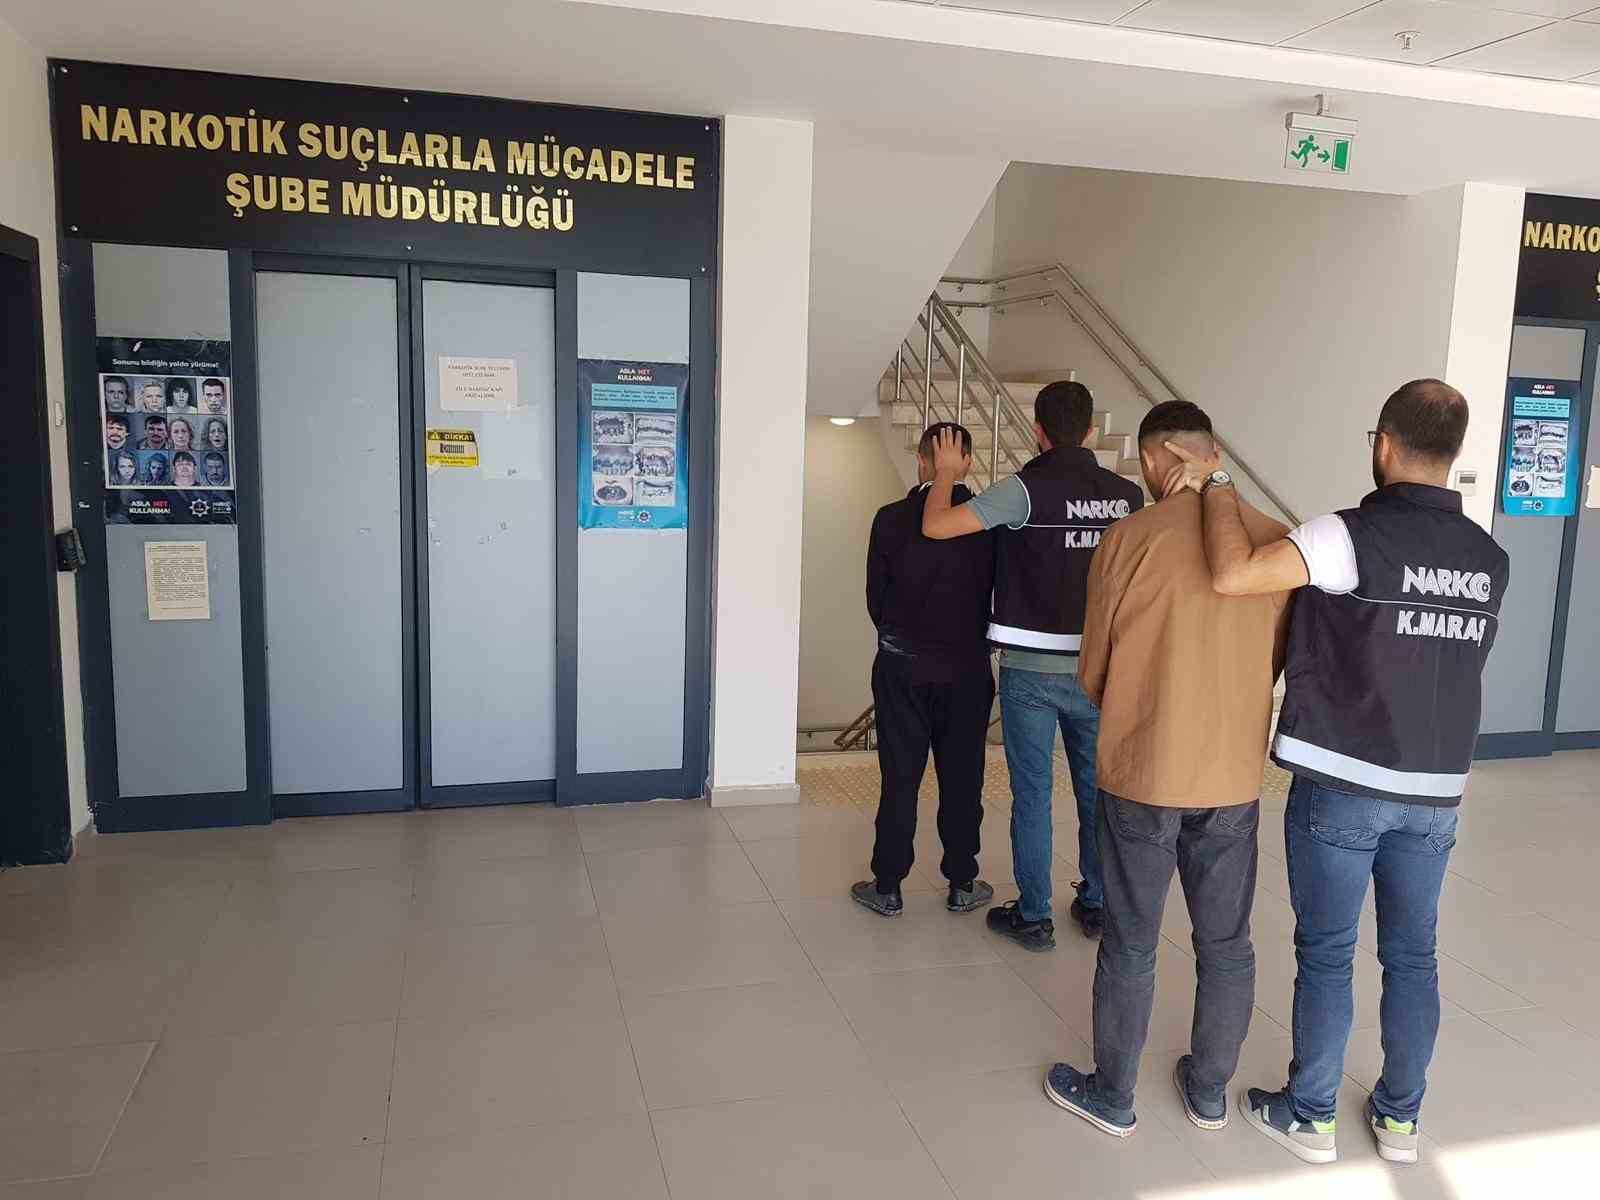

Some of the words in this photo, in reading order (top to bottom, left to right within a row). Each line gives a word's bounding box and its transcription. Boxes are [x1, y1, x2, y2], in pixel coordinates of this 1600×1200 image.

[80, 104, 288, 155] NARKOTİK
[297, 123, 496, 173] SUÇLARLA
[507, 135, 695, 190] MÜCADELE
[225, 172, 330, 218] ŞUBE
[342, 174, 574, 232] MÜDÜRLÜĞÜ
[1524, 221, 1600, 253] NARKO
[141, 359, 168, 368] bildiğin
[169, 360, 190, 368] yolda
